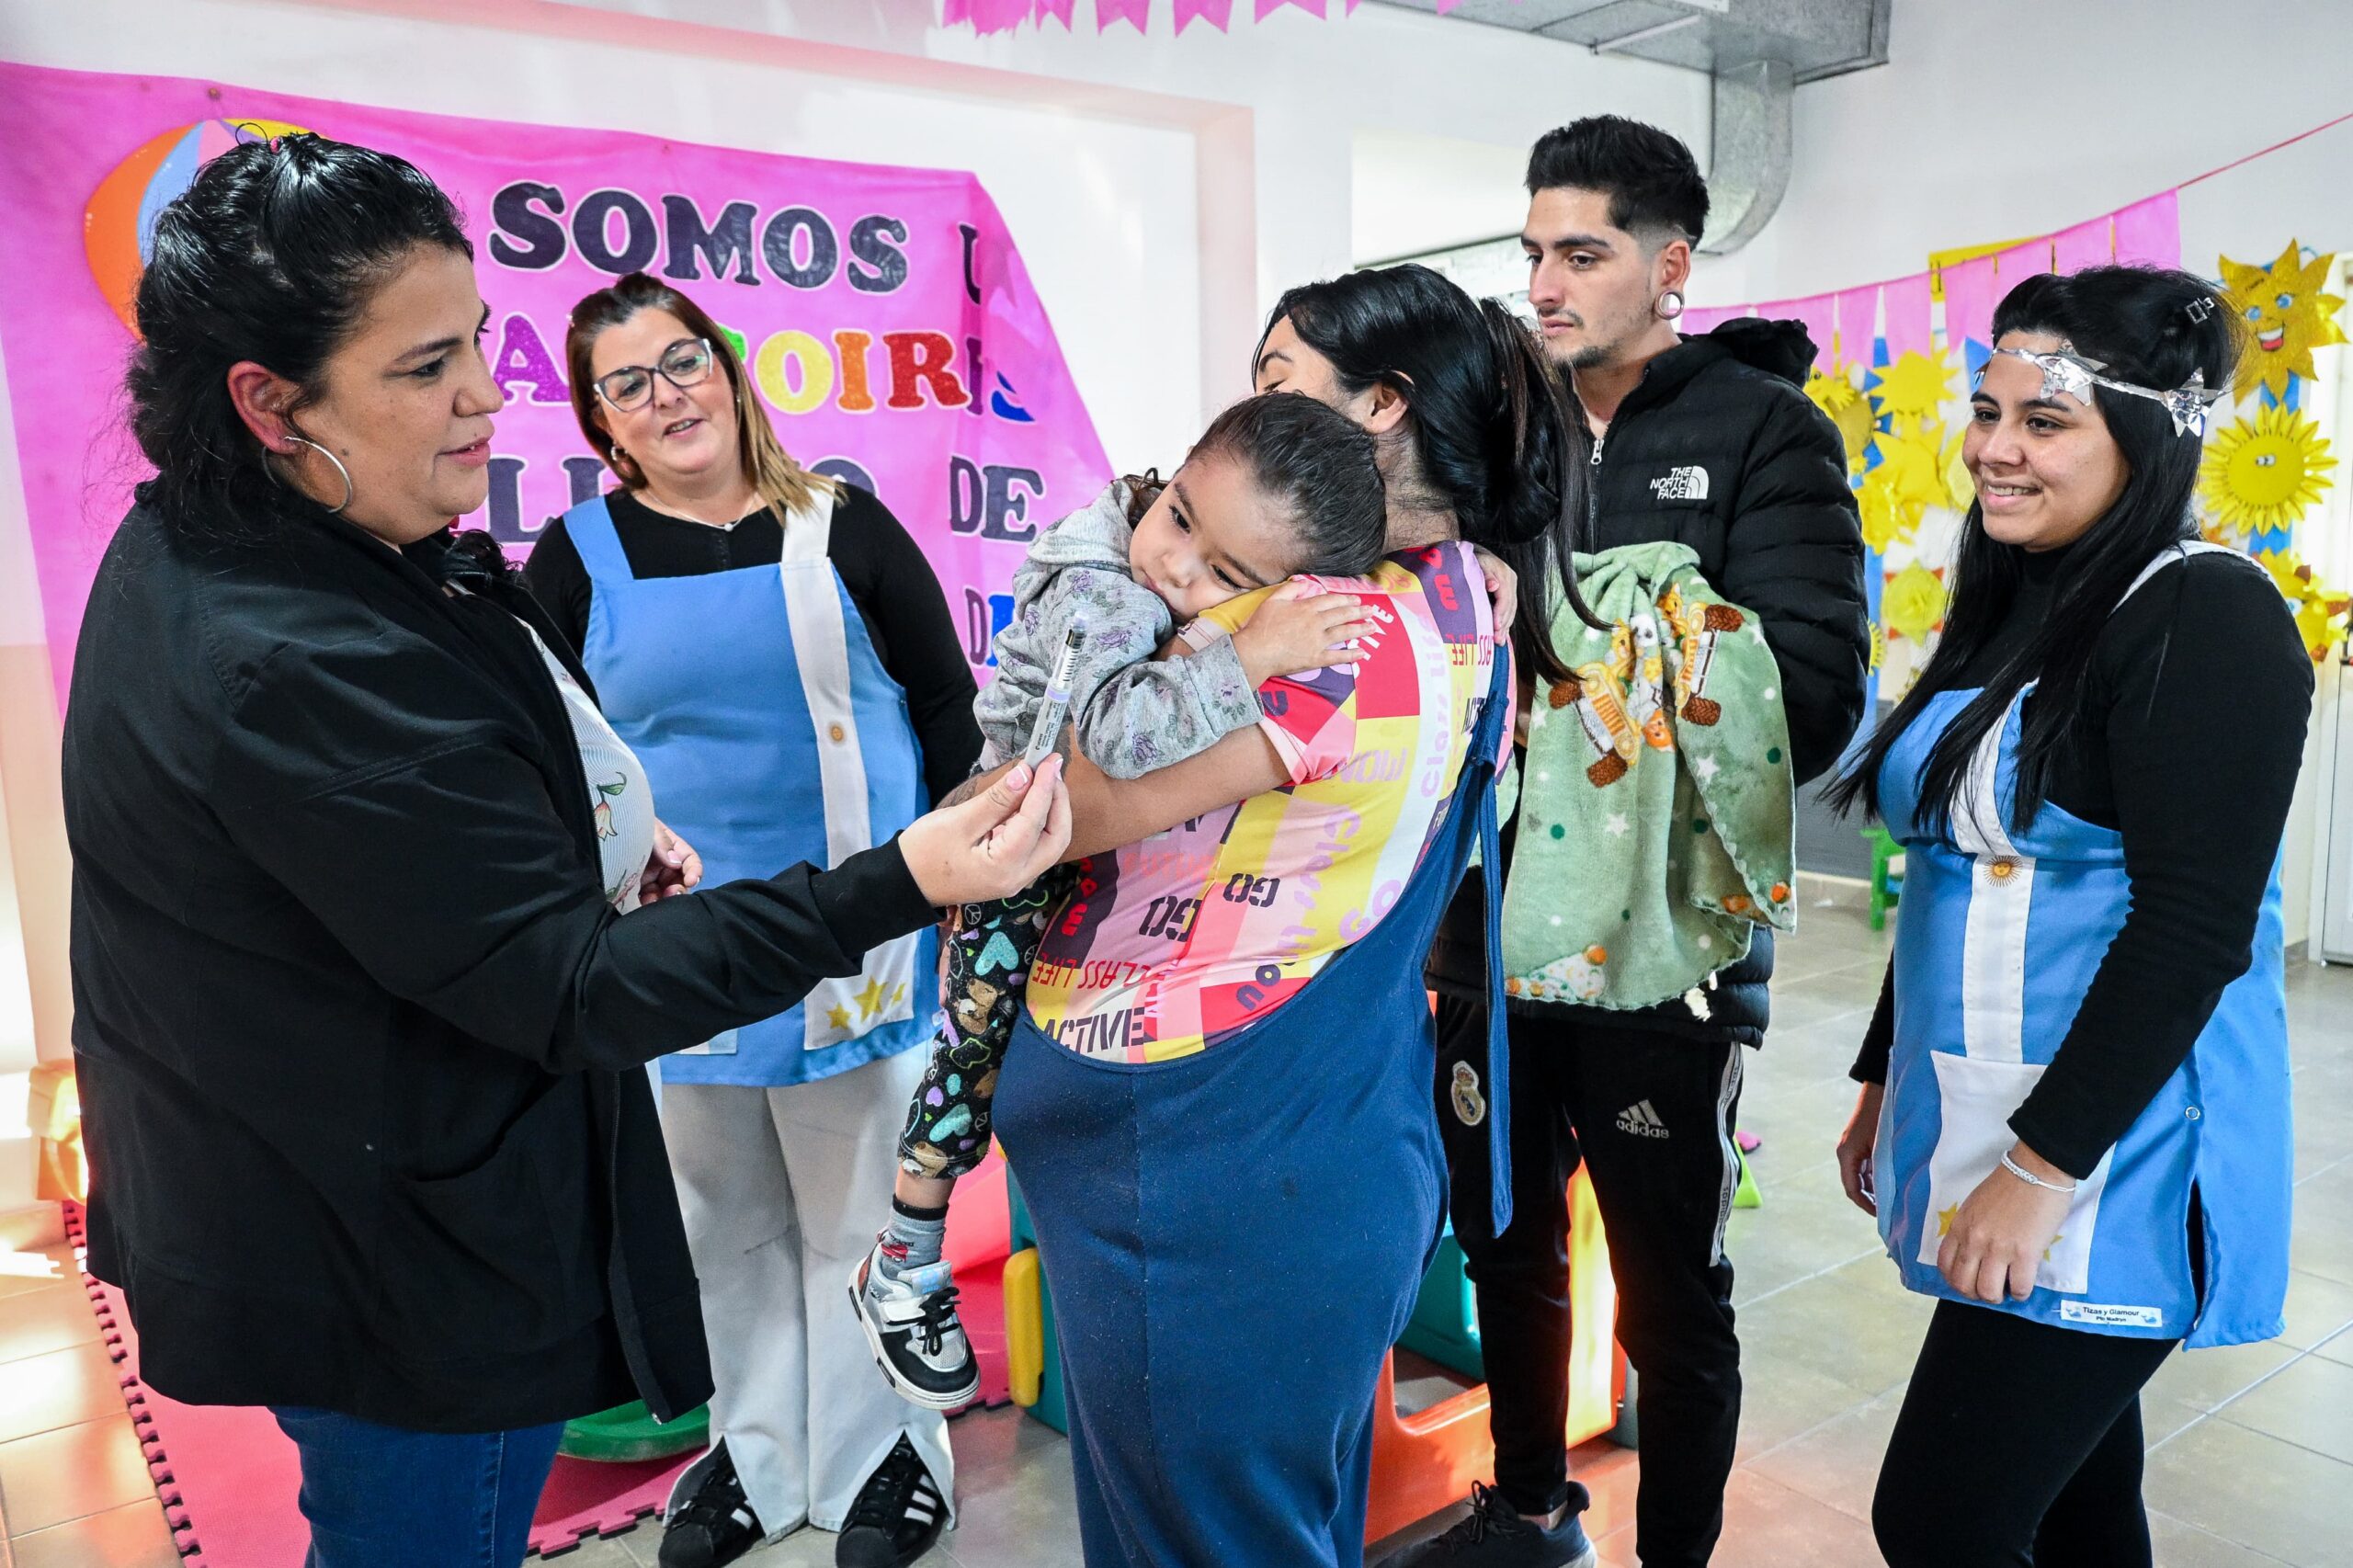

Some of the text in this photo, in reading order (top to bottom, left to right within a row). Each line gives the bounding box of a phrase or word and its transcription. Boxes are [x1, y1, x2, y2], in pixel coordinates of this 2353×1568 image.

[490, 181, 908, 294] SOMOS
[1650, 477, 1688, 489] NORTH
[1671, 467, 1692, 478] THE
[949, 456, 1044, 541] DE
[1657, 488, 1685, 499] FACE
[1031, 951, 1077, 988] LIFE
[1042, 1006, 1145, 1055] ACTIVE
[1616, 1119, 1670, 1139] adidas
